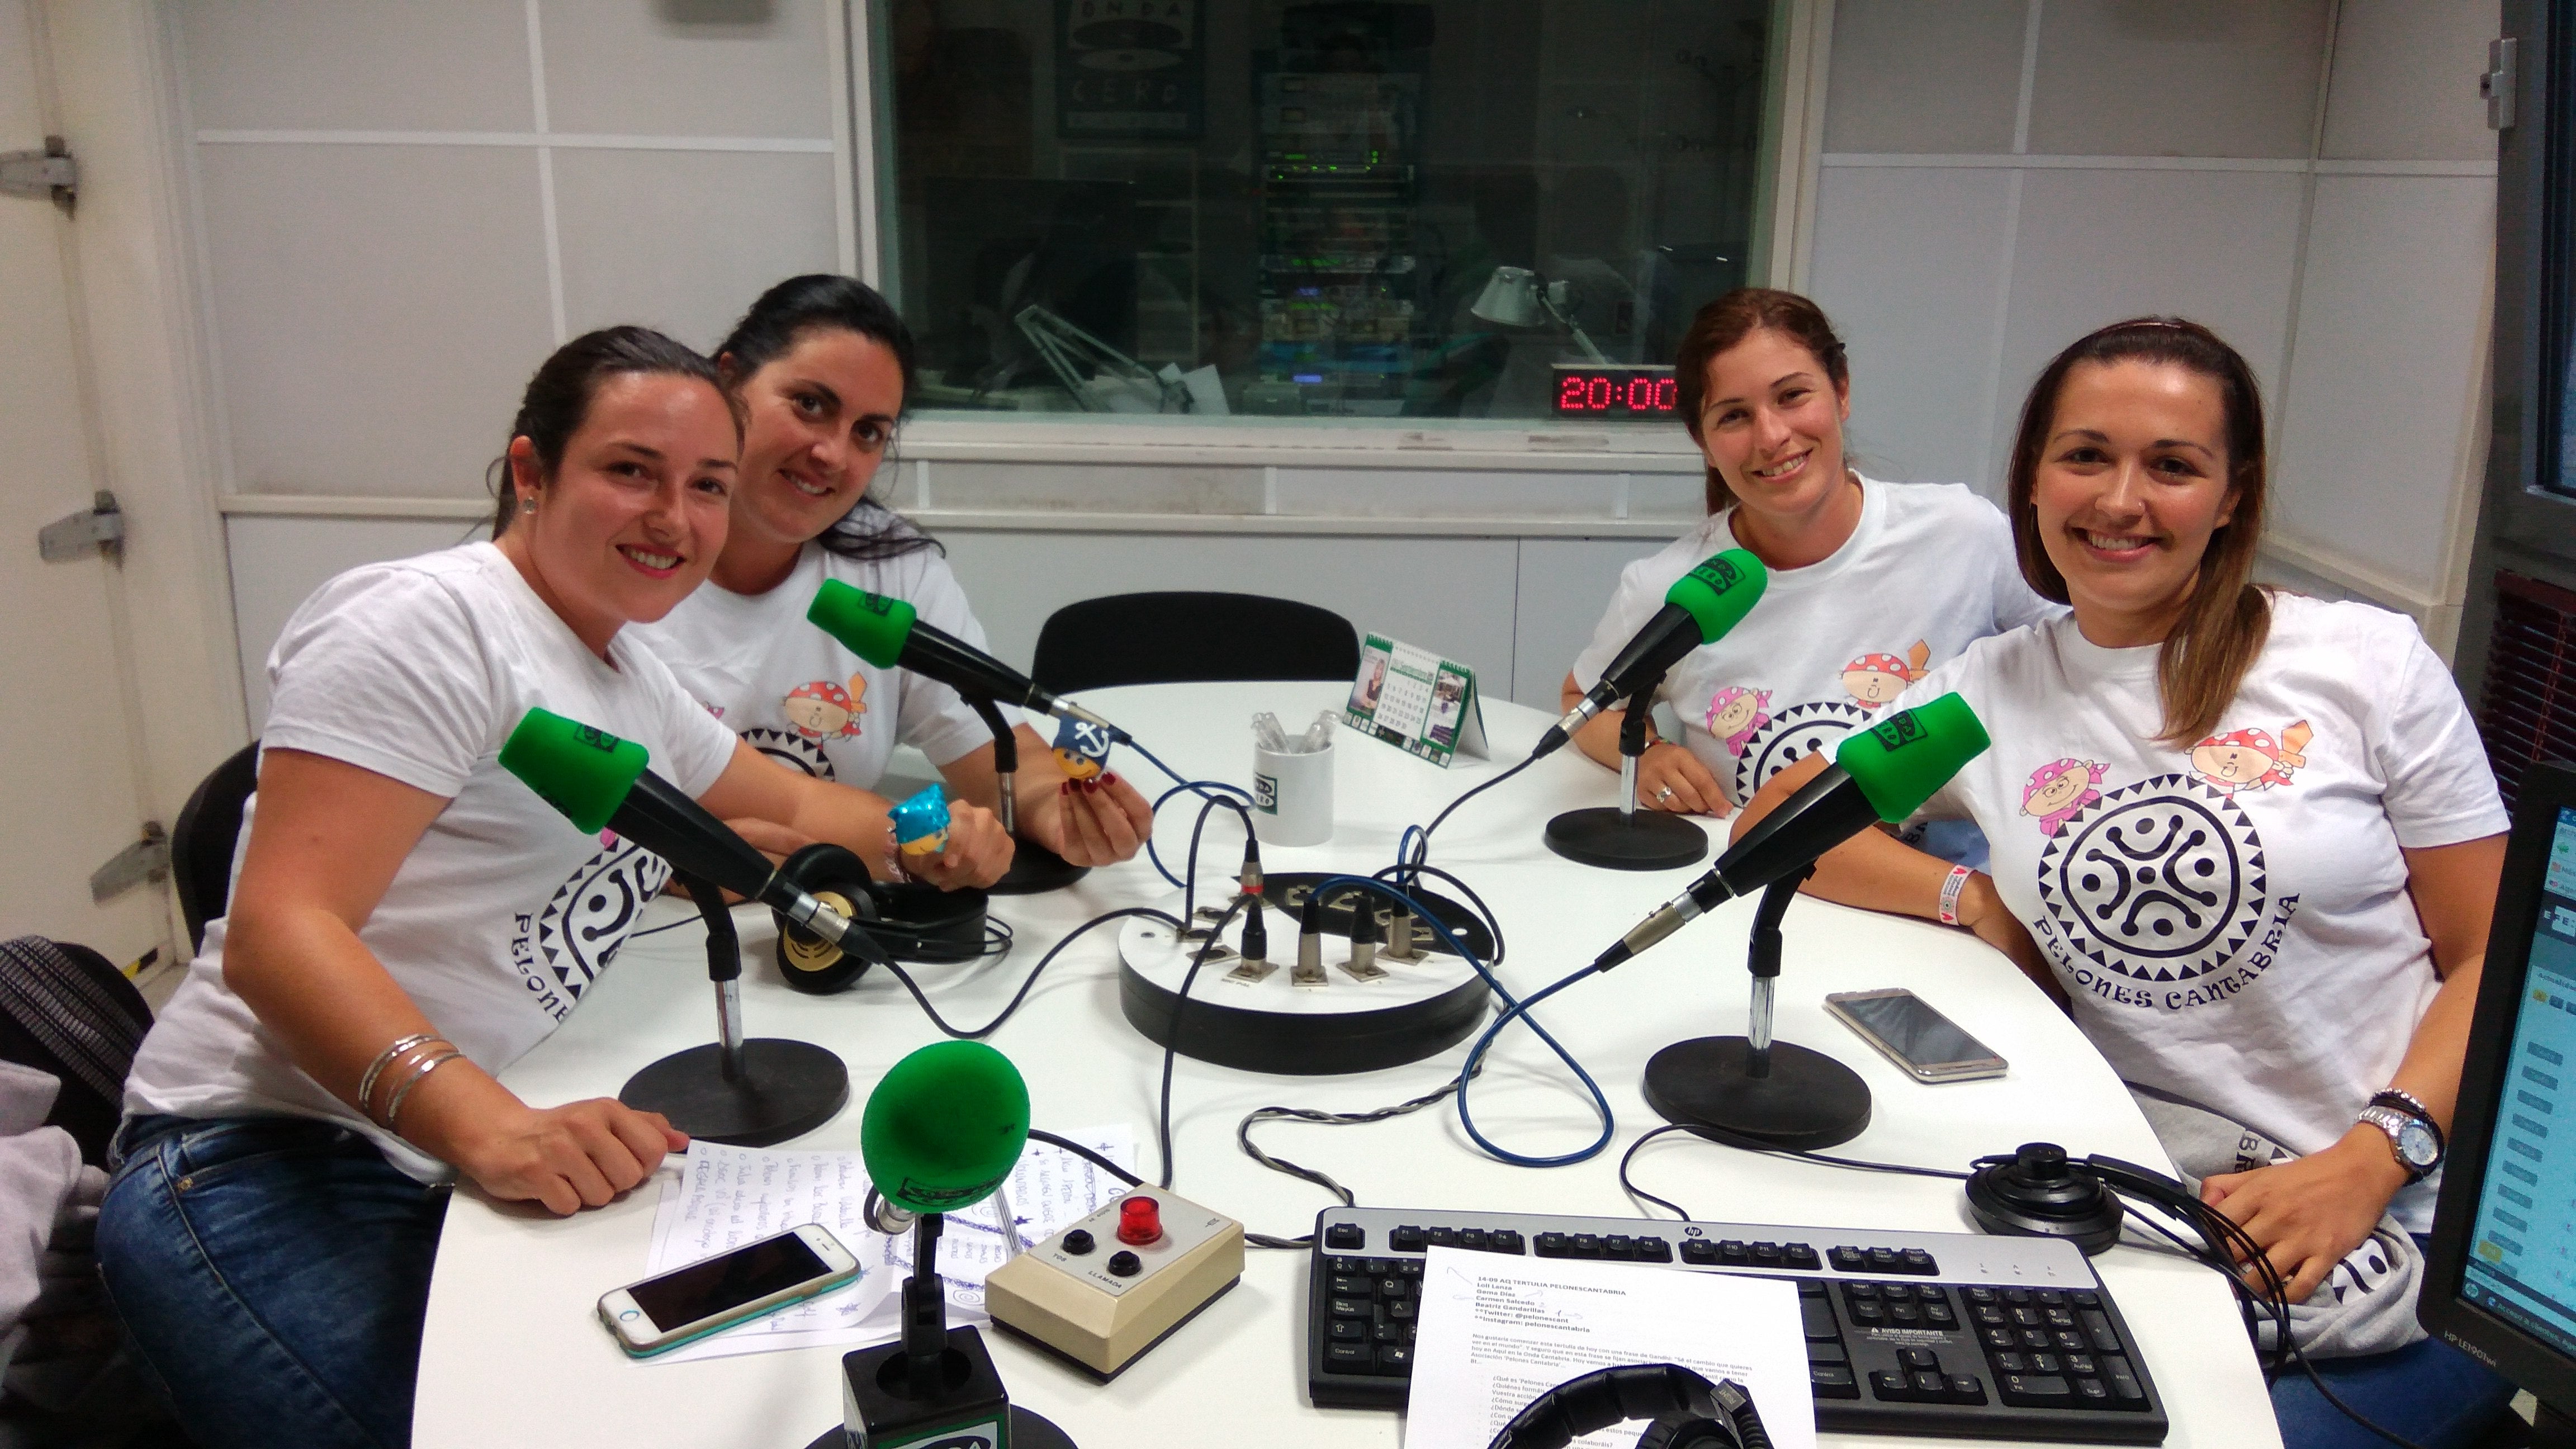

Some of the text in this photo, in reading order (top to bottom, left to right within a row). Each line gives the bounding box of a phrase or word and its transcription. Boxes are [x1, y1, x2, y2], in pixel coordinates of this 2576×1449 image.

[1561, 377, 1677, 410] 20:00
[2033, 892, 2301, 1010] PELONES CANTABRIA
[511, 912, 569, 1023] PELONE
[1686, 1227, 1702, 1237] hp
[1088, 1270, 1122, 1289] LLAMADA
[1513, 1280, 1548, 1288] TERTULIA
[1550, 1283, 1626, 1295] PELONESCANTABRIA
[2445, 1330, 2457, 1342] HP
